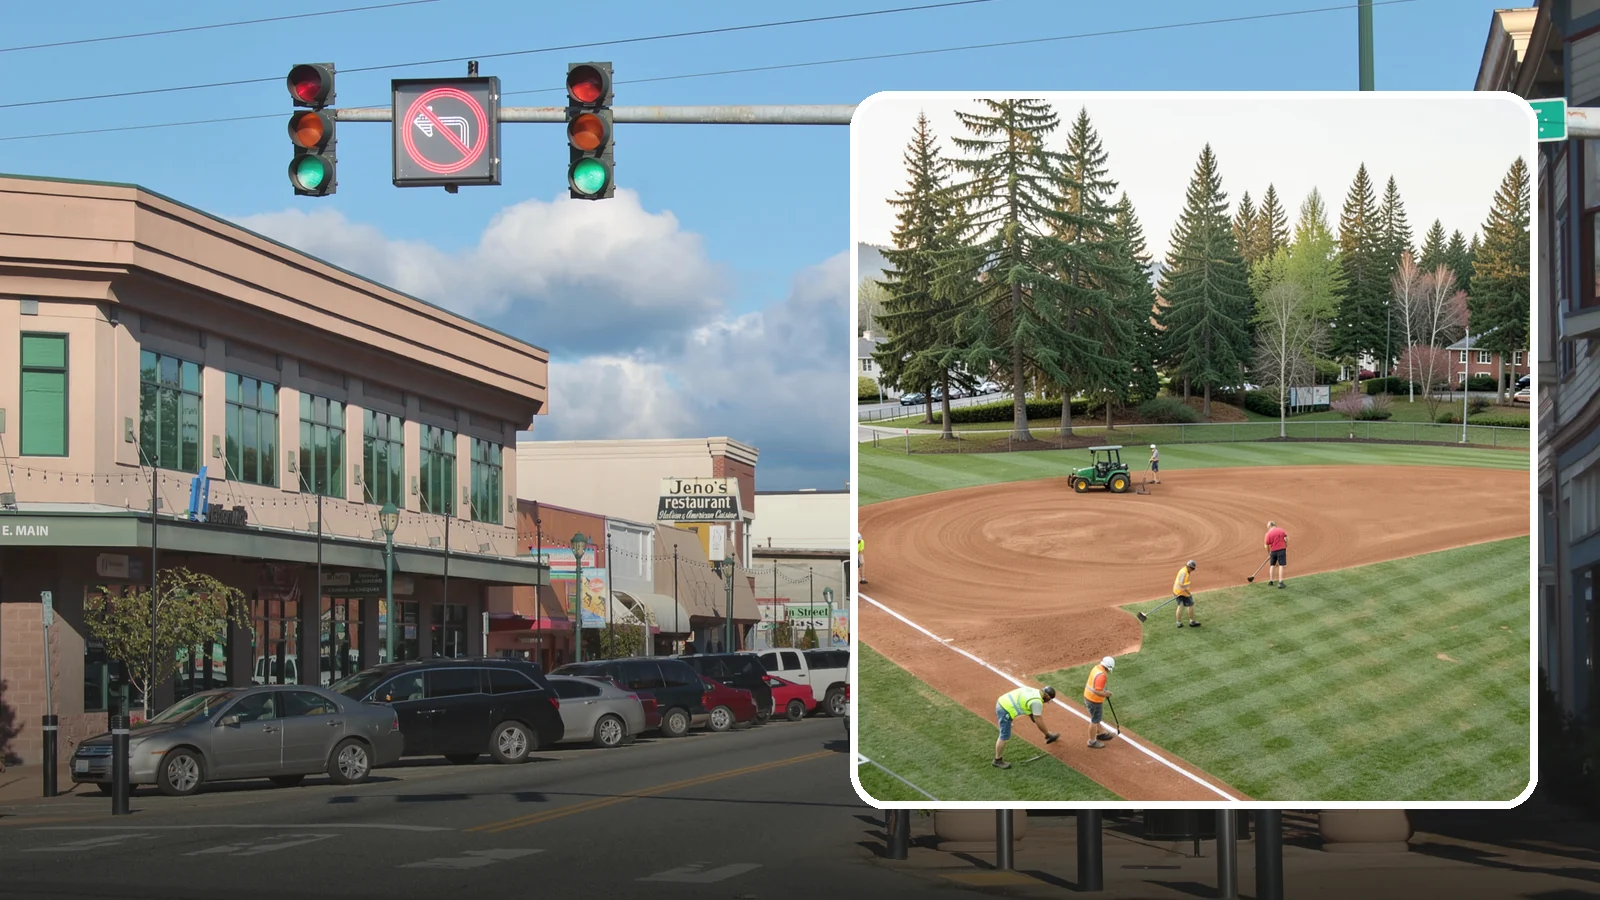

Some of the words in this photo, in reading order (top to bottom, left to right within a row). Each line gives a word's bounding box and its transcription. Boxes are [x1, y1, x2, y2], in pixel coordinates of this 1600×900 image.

[669, 480, 728, 495] Jeno's
[664, 496, 731, 509] restaurant
[686, 510, 714, 519] American
[715, 510, 737, 519] Cuisine
[2, 525, 13, 536] E.
[15, 525, 49, 536] MAIN
[797, 607, 829, 616] Street
